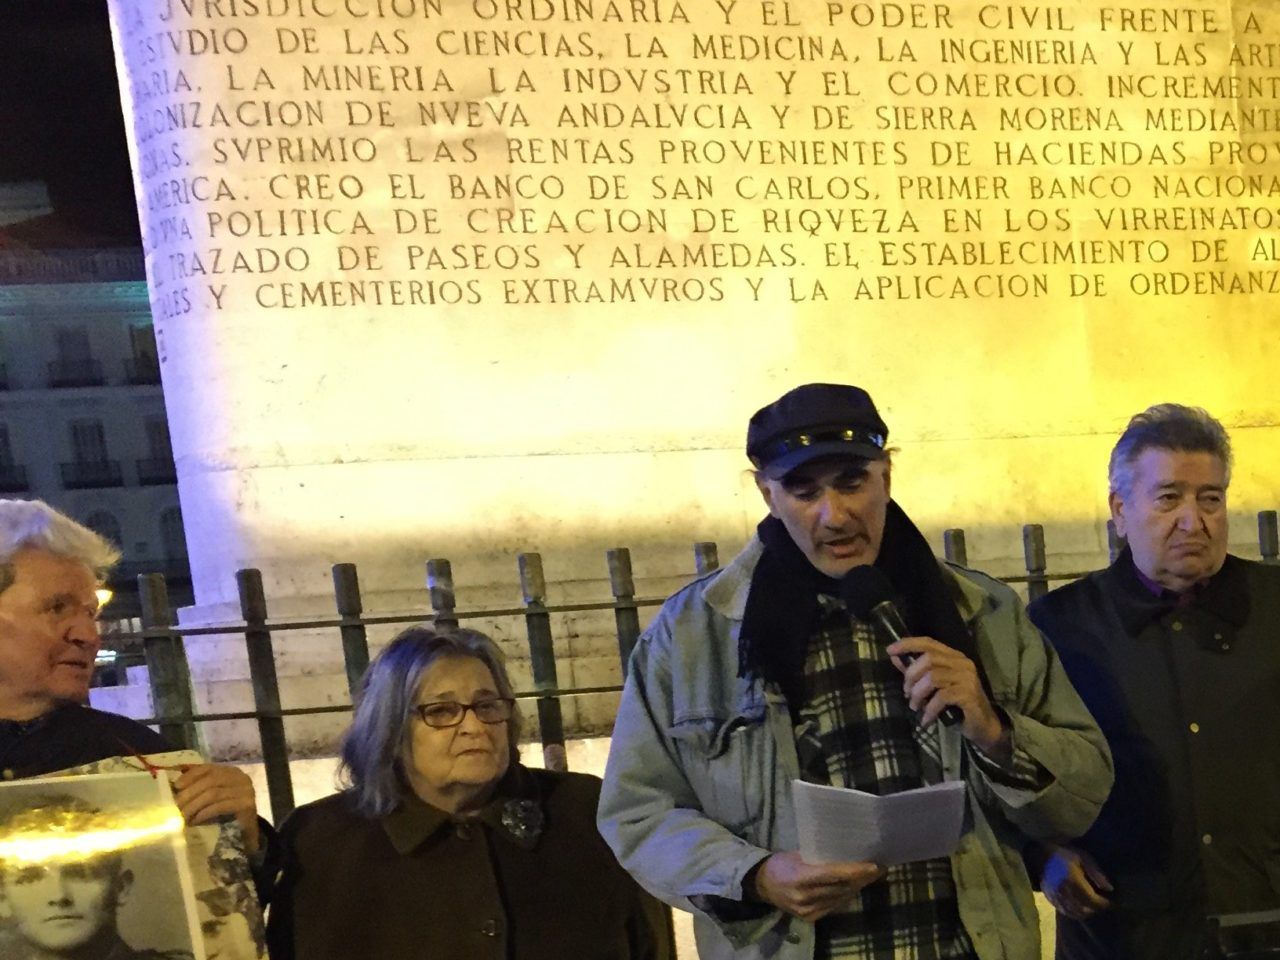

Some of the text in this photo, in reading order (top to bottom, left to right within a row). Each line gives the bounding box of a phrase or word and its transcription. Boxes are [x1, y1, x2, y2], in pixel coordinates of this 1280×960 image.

[473, 0, 690, 23] ORDINARIA
[716, 1, 737, 24] Y
[761, 2, 800, 26] EL
[826, 2, 954, 28] PODER
[978, 5, 1074, 31] CIVIL
[1100, 8, 1218, 33] FRENTE
[1243, 12, 1263, 34] A
[276, 28, 319, 53] DE
[345, 29, 409, 55] LAS
[624, 32, 668, 58] LA
[693, 33, 860, 63] MEDICINA,
[878, 37, 918, 62] LA
[940, 38, 1098, 65] INGENIERIA
[1117, 41, 1134, 65] Y
[1155, 42, 1207, 67] LAS
[227, 65, 276, 91] LA
[302, 65, 455, 92] MINERIA
[488, 67, 536, 93] LA
[563, 68, 754, 95] INDVSTRIA
[776, 70, 797, 95] Y
[822, 72, 861, 96] EL
[888, 72, 1084, 98] COMERCIO.
[346, 101, 395, 127] DE
[418, 102, 530, 128] NVEVA
[557, 103, 752, 129] ANDALVCIA
[770, 105, 790, 129] Y
[813, 105, 854, 130] DE
[876, 106, 976, 131] SIERRA
[1000, 107, 1124, 132] MORENA
[213, 138, 377, 164] SVPRIMIO
[405, 138, 478, 163] LAS
[507, 138, 635, 165] RENTAS
[659, 140, 909, 166] PROVENIENTES
[930, 141, 972, 166] DE
[994, 142, 1186, 166] HACIENDAS
[269, 175, 364, 200] CREO
[388, 175, 426, 200] EL
[450, 174, 564, 200] BANCO
[588, 175, 629, 200] DE
[651, 175, 713, 200] SAN
[736, 175, 880, 201] CARLOS,
[898, 176, 1011, 200] PRIMER
[1029, 176, 1132, 199] BANCO
[207, 209, 375, 238] POLITICA
[393, 209, 442, 235] DE
[467, 208, 667, 234] CREACION
[693, 208, 739, 233] DE
[763, 208, 920, 237] RIQVEZA
[943, 209, 982, 233] EN
[1005, 208, 1071, 232] LOS
[169, 247, 310, 282] TRAZADO
[337, 246, 383, 271] DE
[407, 245, 541, 270] PASEOS
[564, 244, 585, 269] Y
[609, 243, 805, 268] ALAMEDAS.
[881, 241, 1170, 266] ESTABLECIMIENTO
[1191, 239, 1229, 264] DE
[208, 284, 228, 310] Y
[255, 280, 482, 308] CEMENTERIOS
[503, 277, 725, 304] EXTRAMVROS
[745, 277, 764, 302] Y
[789, 277, 828, 303] LA
[855, 274, 1049, 300] APLICACION
[1070, 274, 1108, 297] DE
